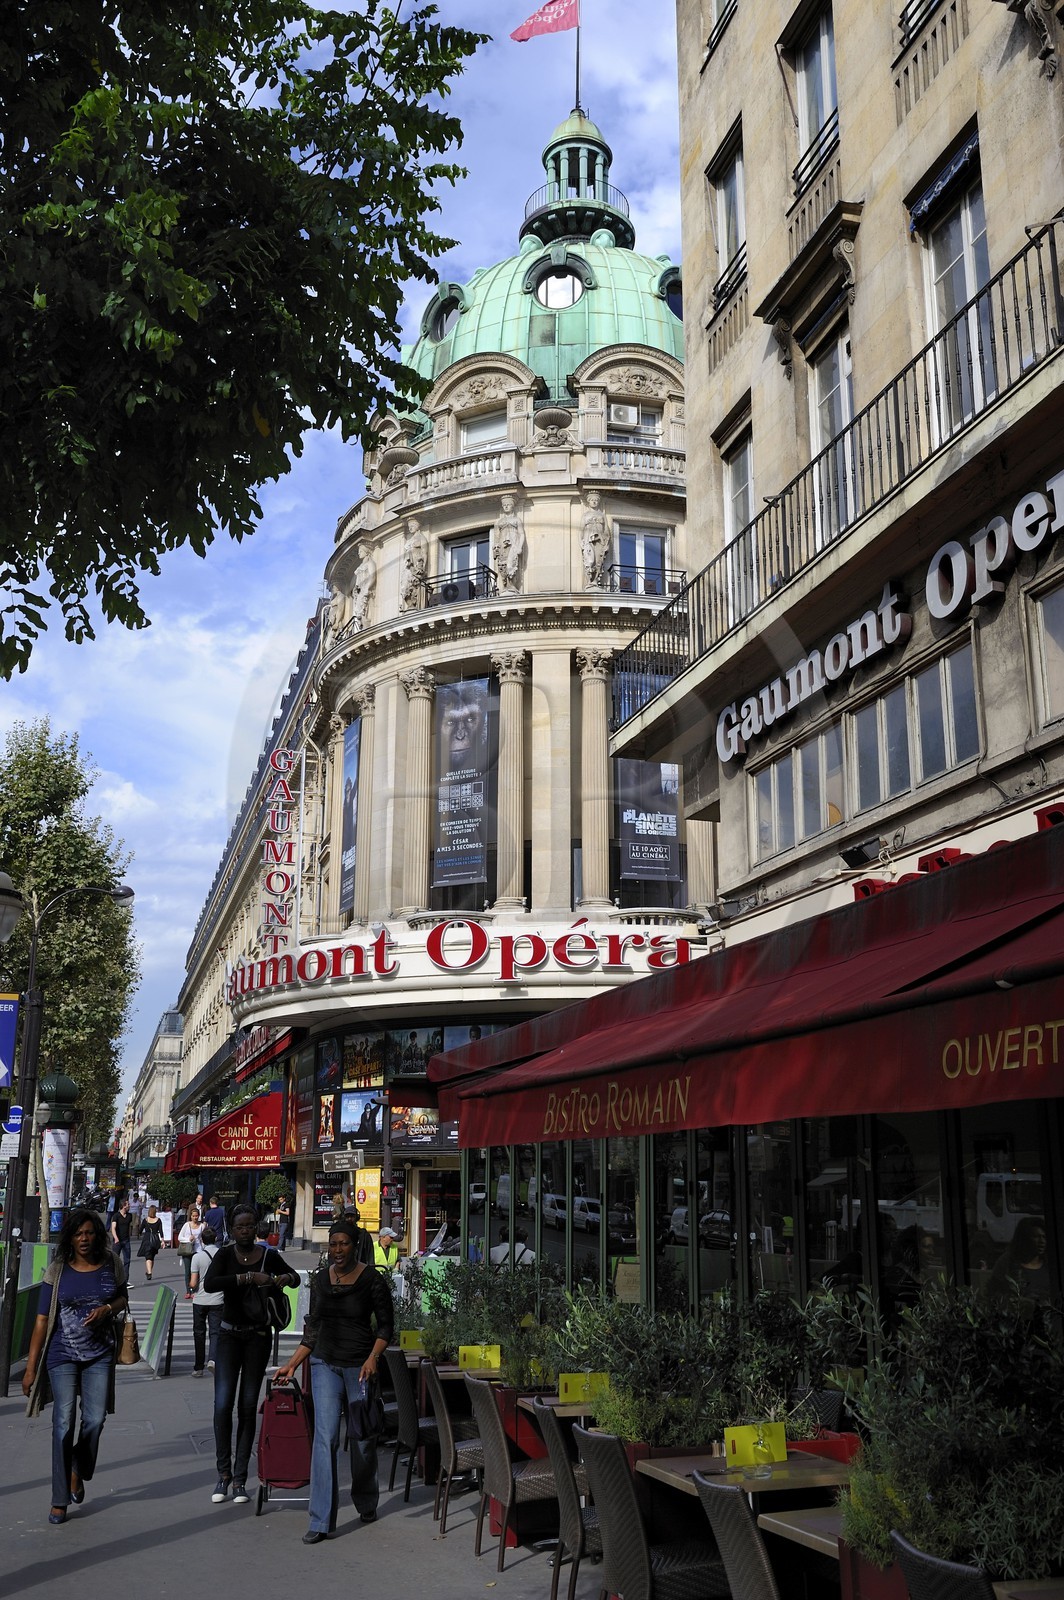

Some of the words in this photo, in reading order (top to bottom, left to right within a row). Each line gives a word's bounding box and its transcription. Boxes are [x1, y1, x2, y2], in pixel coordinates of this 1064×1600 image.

[715, 581, 910, 763] Gaumont
[635, 821, 677, 831] SINGES
[262, 748, 296, 954] GAUMONT
[649, 845, 668, 853] AOÛT
[226, 931, 400, 1004] aumont
[426, 917, 691, 981] Opéra
[942, 1019, 1064, 1079] OUVERT
[243, 1113, 253, 1125] LE
[543, 1087, 600, 1135] BISTRO
[606, 1076, 691, 1131] ROMAIN
[217, 1126, 249, 1138] GRAND
[254, 1126, 278, 1137] CAFE
[221, 1139, 274, 1150] CAPUCINES
